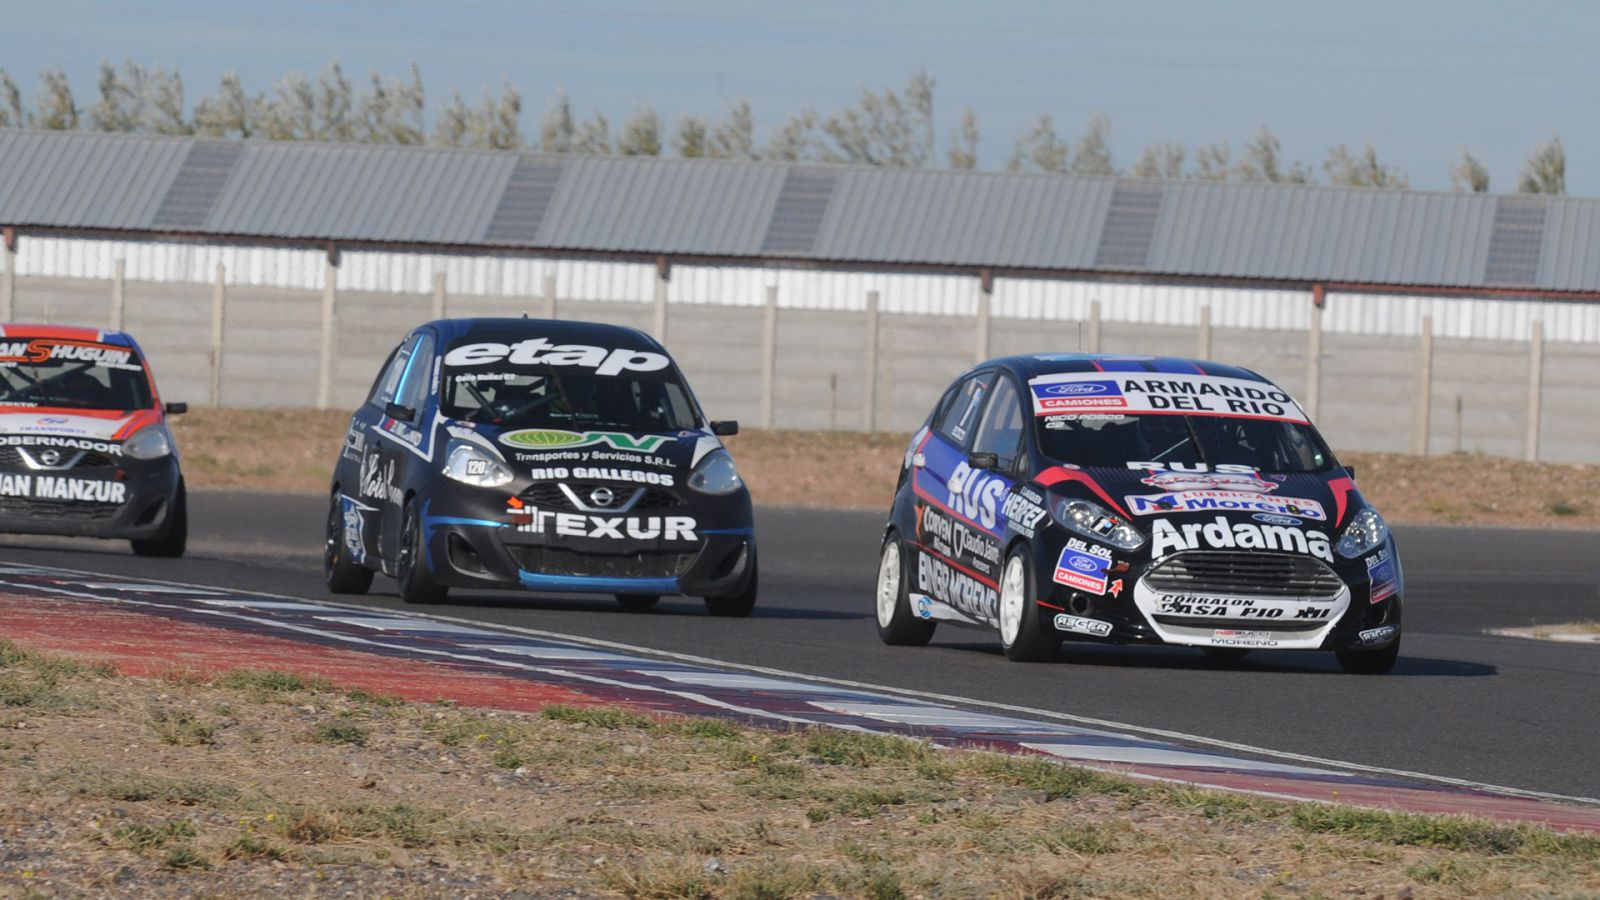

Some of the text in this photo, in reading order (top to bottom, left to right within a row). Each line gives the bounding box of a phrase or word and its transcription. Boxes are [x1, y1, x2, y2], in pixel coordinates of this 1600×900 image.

[445, 338, 670, 376] etap
[1058, 384, 1094, 394] Ford
[1125, 380, 1291, 403] ARMANDO
[1045, 399, 1123, 407] CAMIONES
[1151, 395, 1285, 416] DEL RIO
[516, 453, 580, 463] Transportes
[582, 453, 590, 461] y
[592, 451, 642, 463] Servicios
[468, 461, 485, 474] 120
[1127, 461, 1258, 474] RUS
[532, 468, 674, 486] RIO GALLEGOS
[0, 474, 126, 503] AN MANZUR
[948, 461, 1004, 530] RUS
[1183, 491, 1314, 507] LUBRICANTES
[1185, 498, 1322, 518] Moreno
[1263, 513, 1293, 524] Ford
[1151, 516, 1334, 563] Ardama
[1067, 538, 1113, 559] DEL SOL
[1057, 573, 1103, 592] CAMIONES
[1162, 594, 1254, 606] CORRALON
[1159, 604, 1228, 616] CASA
[1240, 608, 1284, 618] PIO
[1211, 638, 1278, 646] MORENO
